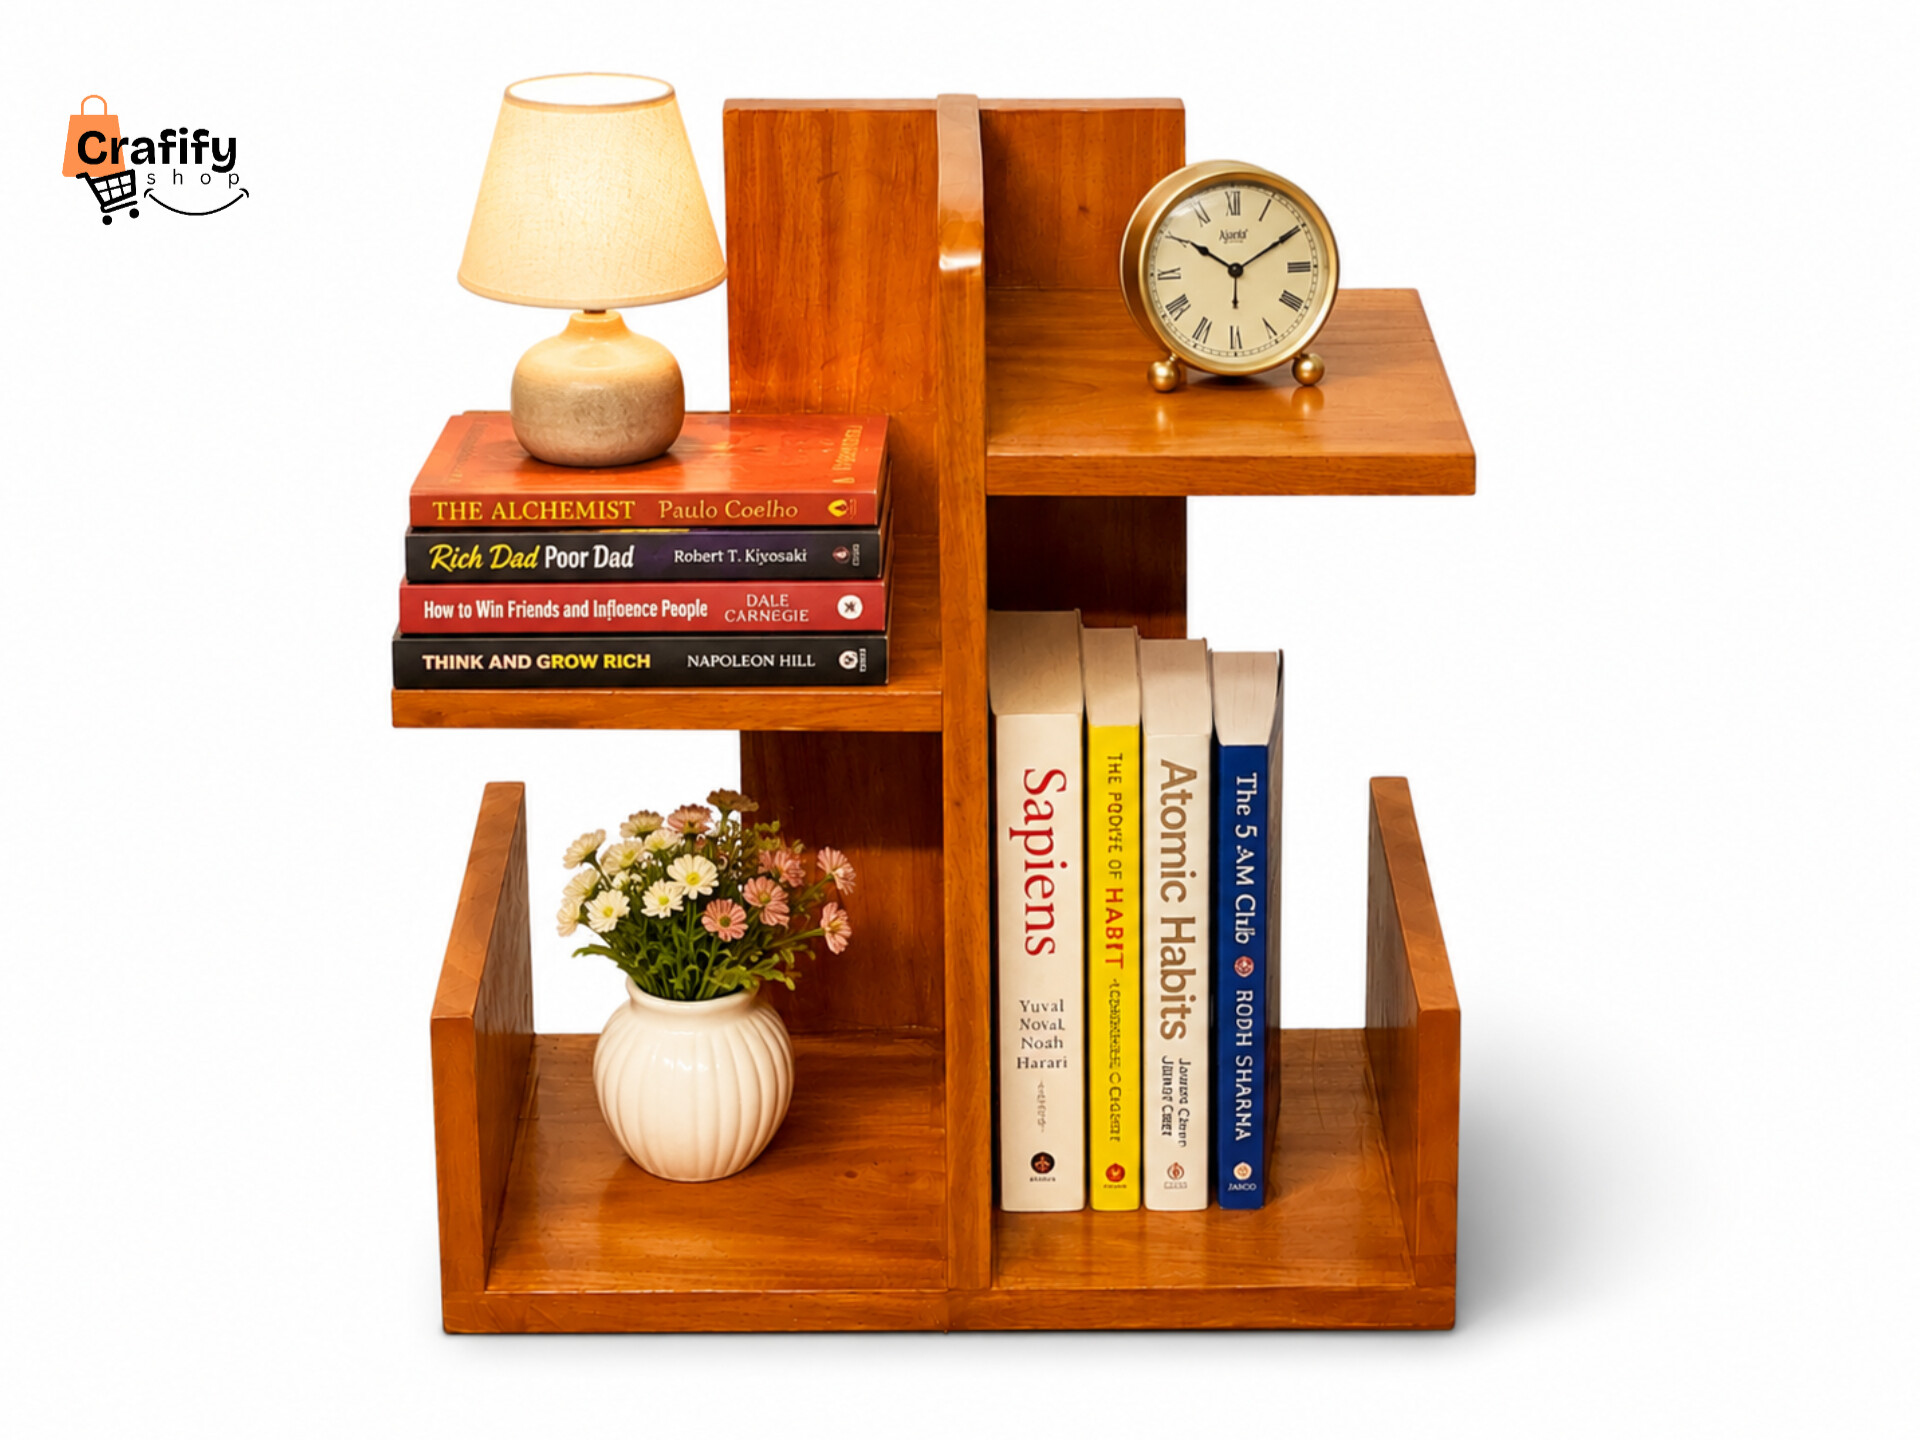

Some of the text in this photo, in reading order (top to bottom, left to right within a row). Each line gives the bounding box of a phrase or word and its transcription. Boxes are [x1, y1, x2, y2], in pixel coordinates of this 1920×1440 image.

[1225, 191, 1241, 216] XII
[432, 500, 635, 521] THE ALCHEMIST
[659, 500, 799, 520] Paulo Coelho
[429, 543, 635, 570] Rich Dad Poor Dad
[673, 548, 724, 563] Robert
[727, 549, 742, 563] T.
[424, 600, 453, 619] How
[457, 602, 473, 618] to
[476, 599, 504, 619] Win
[507, 600, 559, 619] Friends
[563, 599, 590, 618] and
[662, 599, 709, 620] People
[746, 593, 789, 608] DALE
[724, 608, 810, 623] CARNEGIE
[422, 654, 651, 670] THINK AND GROW RICH
[687, 654, 816, 669] NAPOLEON HILL
[1107, 752, 1123, 784] THE
[1235, 772, 1258, 816] The
[1160, 759, 1198, 903] Atomic
[1235, 824, 1258, 838] 5
[1009, 768, 1068, 956] Sapiens
[1108, 859, 1122, 880] OF
[1235, 845, 1256, 885] AM
[1105, 888, 1124, 969] HABIT
[1160, 916, 1197, 1040] Habits
[1019, 998, 1064, 1013] Yuval
[1020, 1036, 1064, 1050] Noah
[1016, 1056, 1068, 1069] Harari
